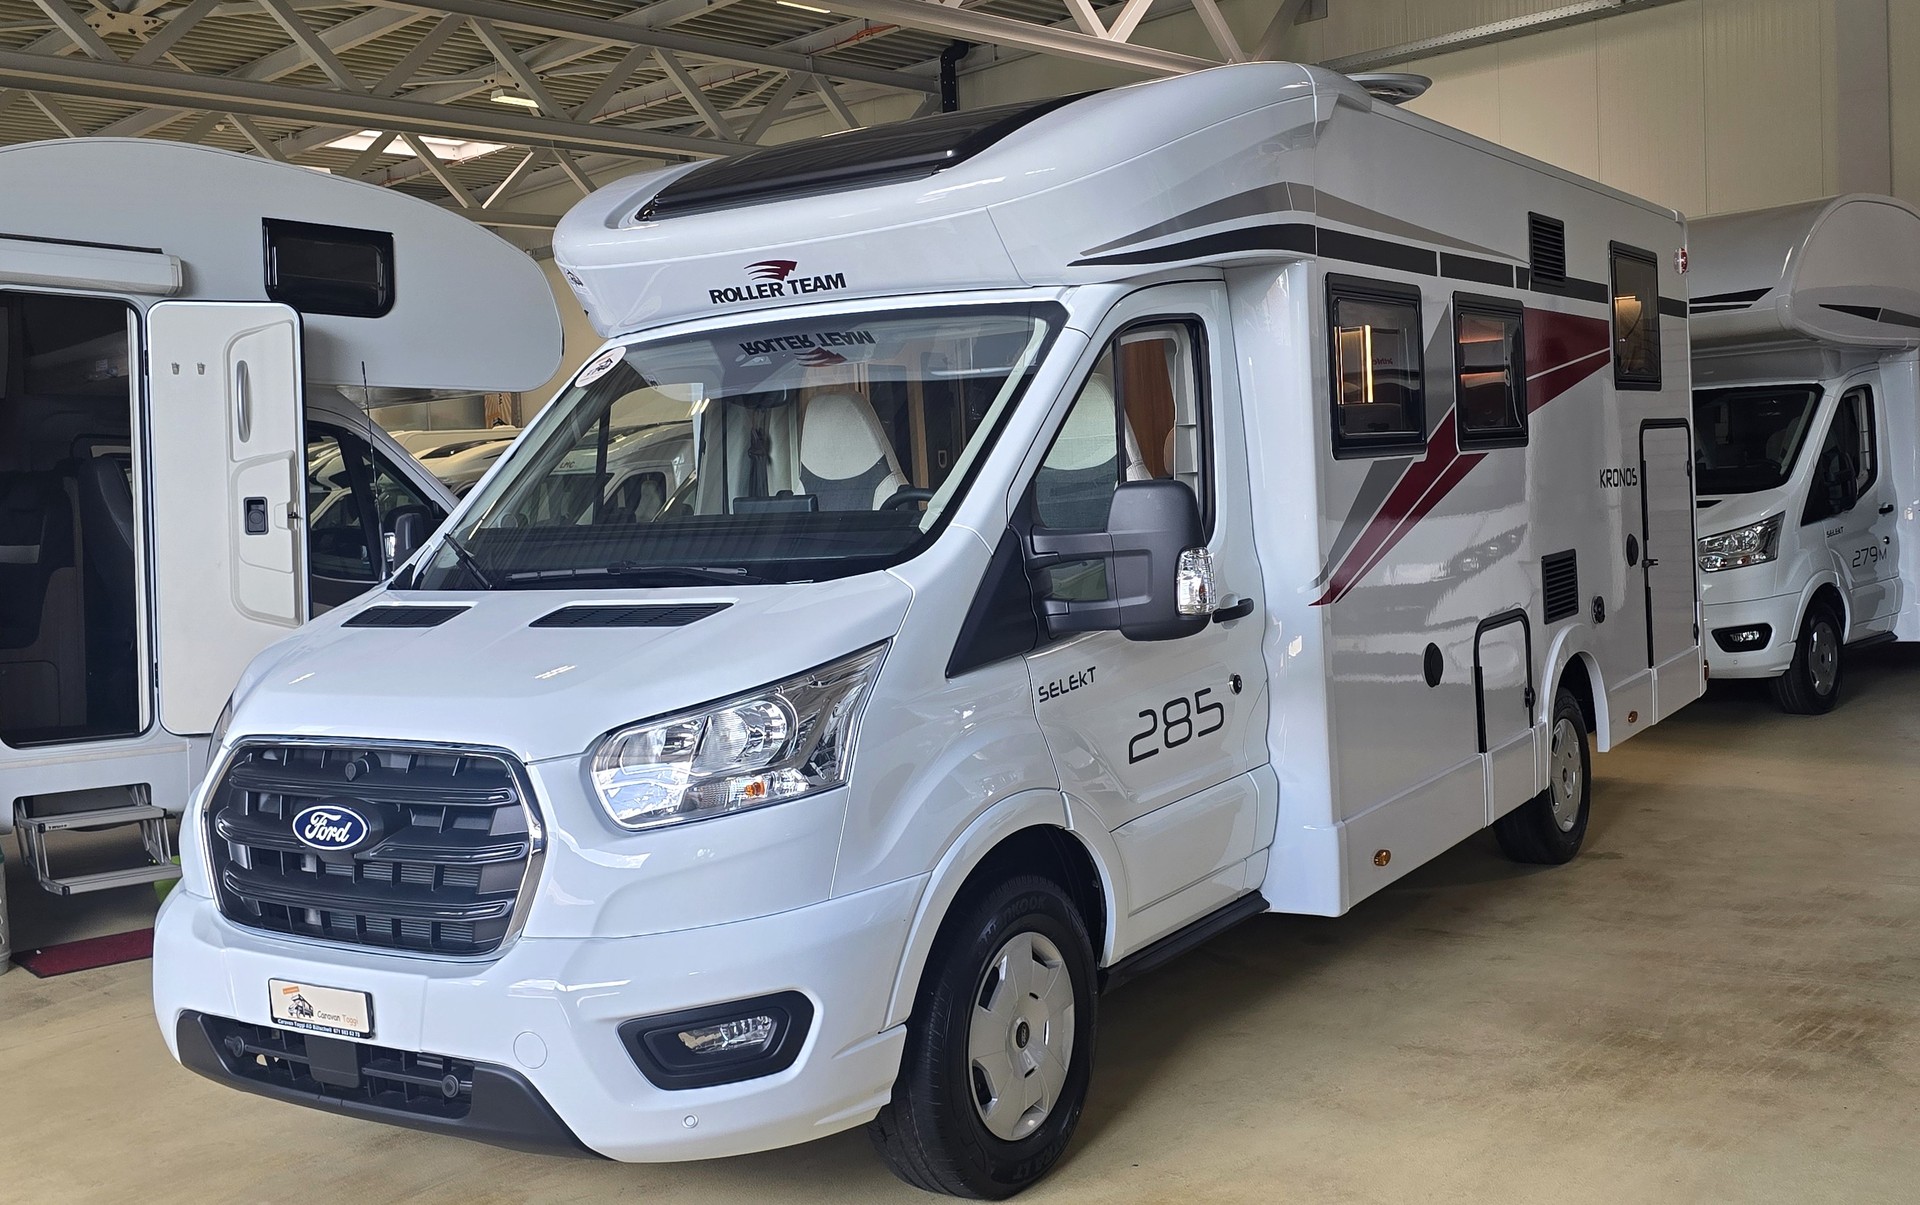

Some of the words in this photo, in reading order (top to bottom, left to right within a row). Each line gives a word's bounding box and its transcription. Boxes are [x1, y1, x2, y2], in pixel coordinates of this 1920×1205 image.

[708, 281, 785, 304] ROLLER
[787, 272, 847, 295] TEAM
[1600, 467, 1637, 489] KRONOS
[1038, 666, 1096, 703] SELEKT
[1128, 687, 1225, 765] 285
[304, 811, 352, 843] Ford
[317, 1010, 341, 1022] Caravan
[341, 1014, 359, 1027] Toggi
